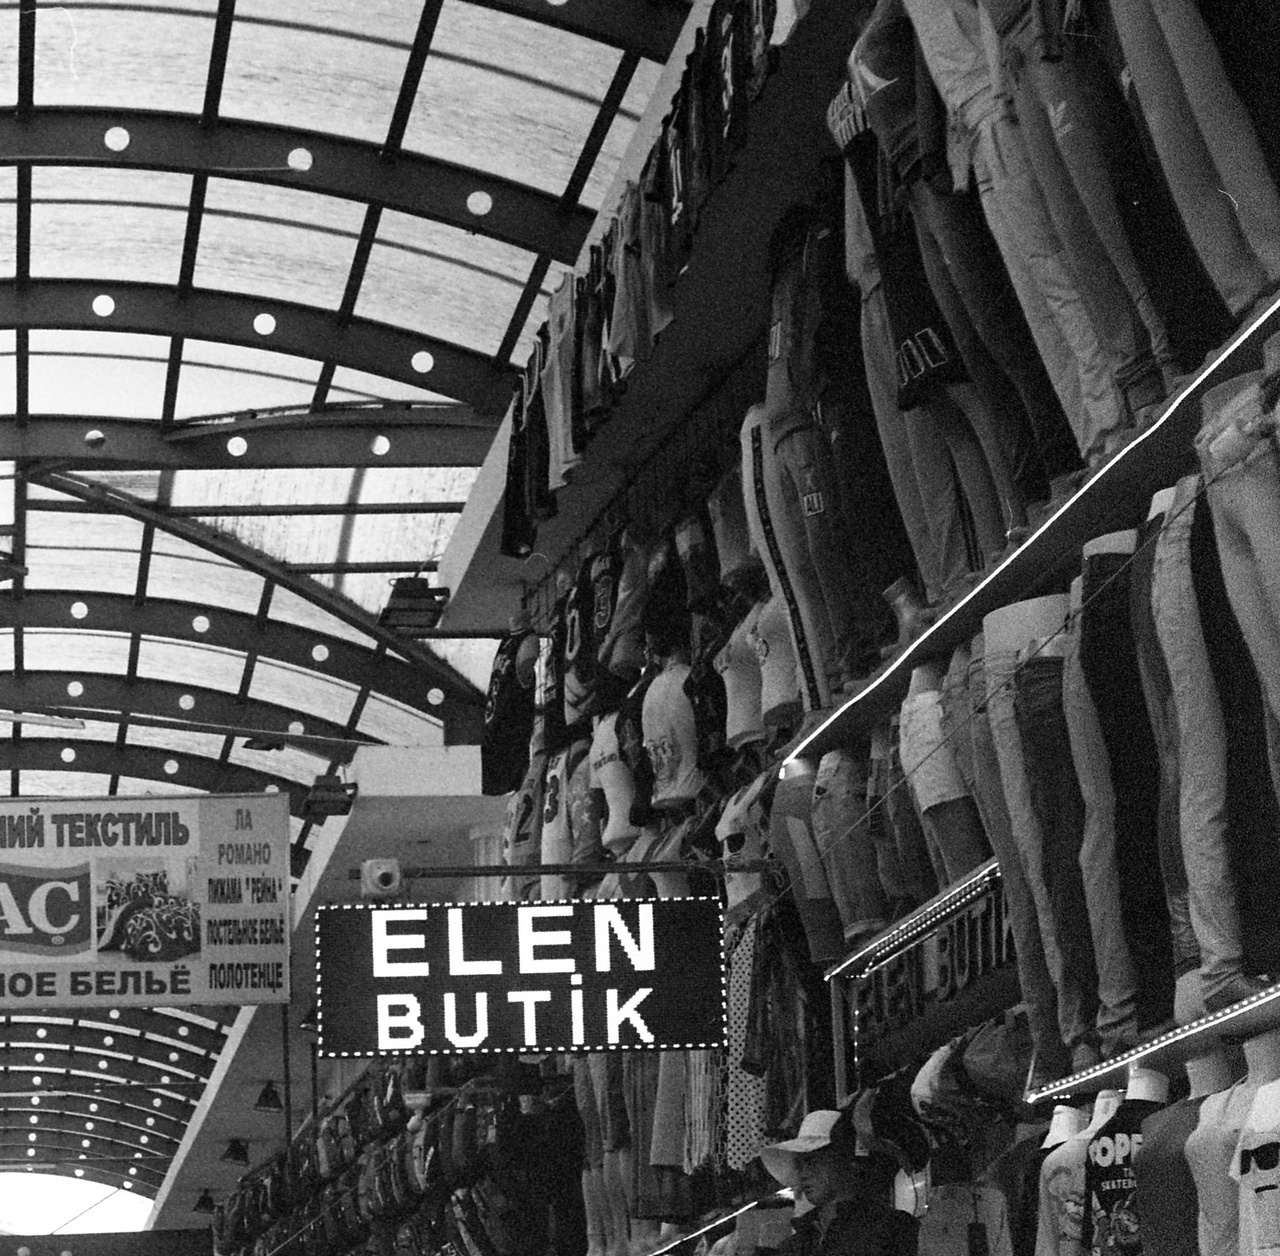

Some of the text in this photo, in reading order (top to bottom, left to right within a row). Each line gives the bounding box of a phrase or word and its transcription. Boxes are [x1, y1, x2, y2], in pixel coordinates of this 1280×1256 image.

[51, 812, 190, 848] ТЕКСТИЛЬ
[218, 842, 271, 865] РОМАНО
[372, 904, 655, 977] ELEN
[70, 965, 191, 996] БЕЛЬЁ
[373, 973, 654, 1050] BUTİK
